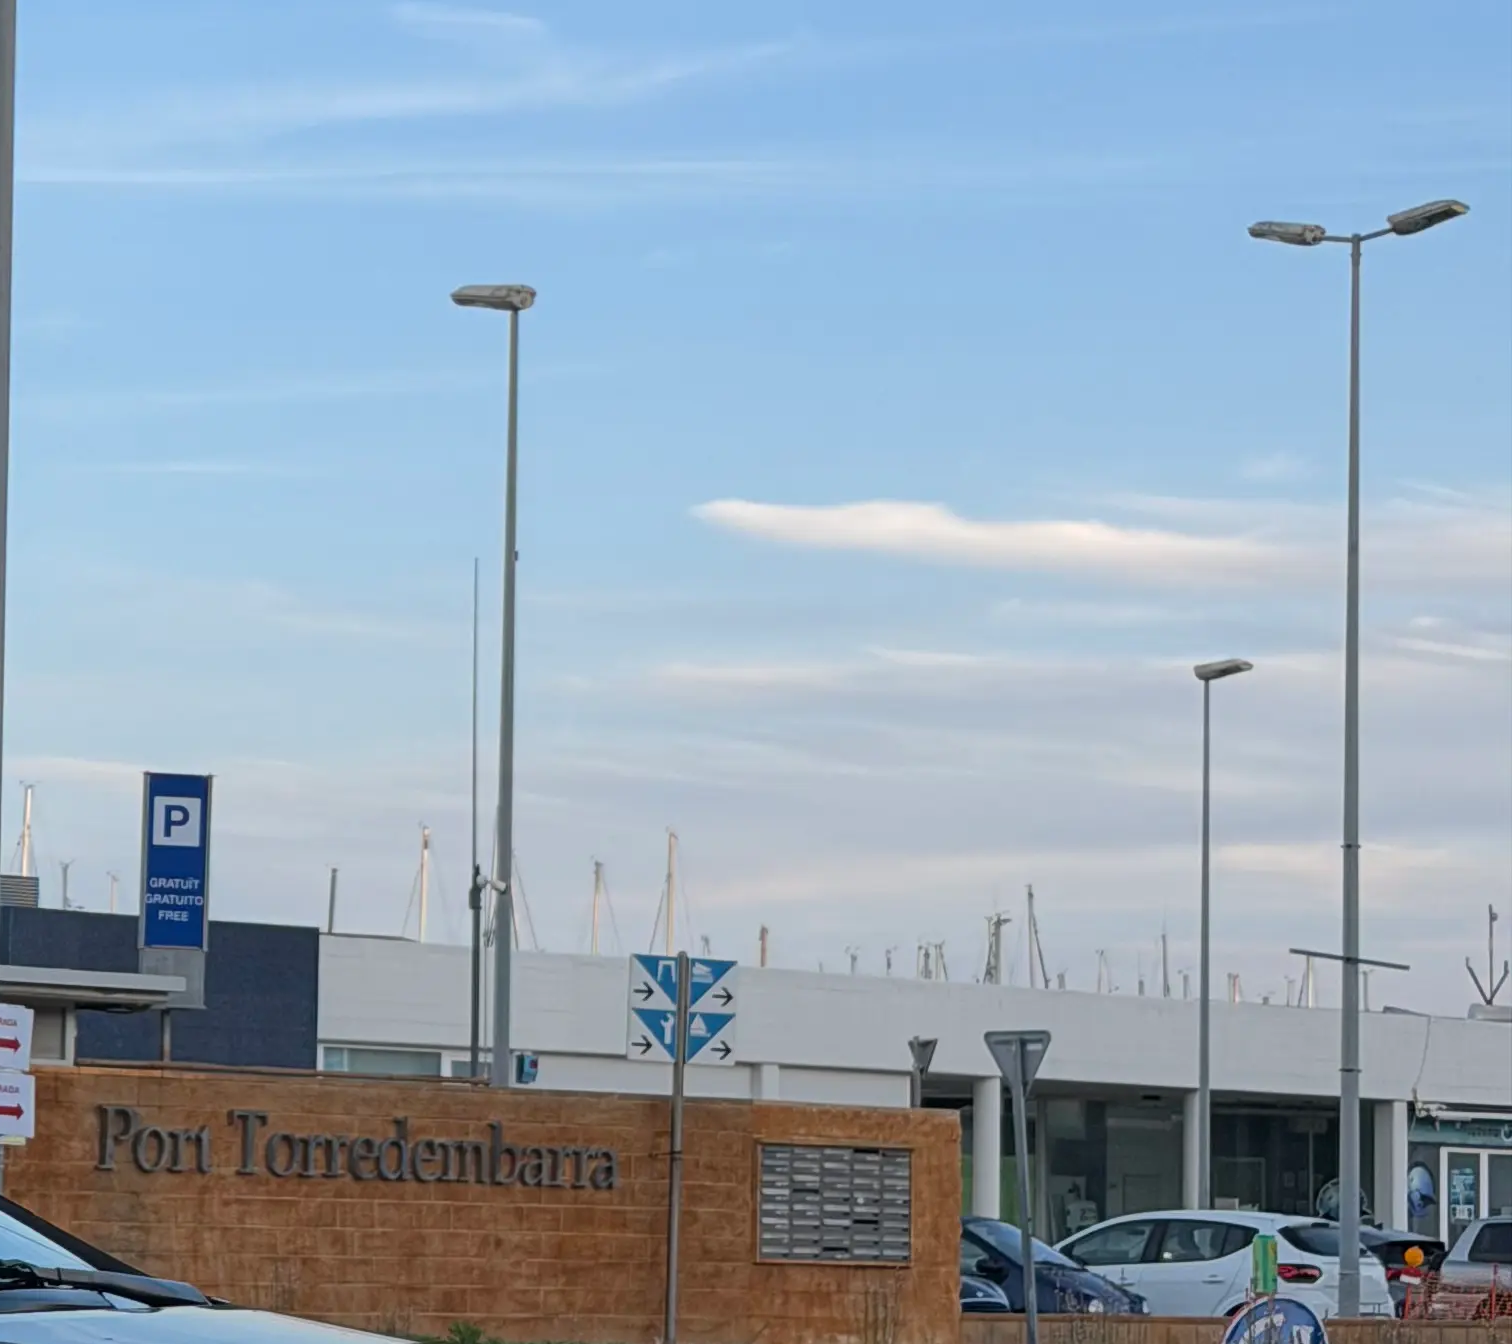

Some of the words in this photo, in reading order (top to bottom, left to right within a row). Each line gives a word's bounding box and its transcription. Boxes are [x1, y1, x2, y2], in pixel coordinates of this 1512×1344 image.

[163, 804, 190, 838] P
[145, 893, 204, 906] GRATUITO
[158, 909, 189, 921] FREE
[95, 1103, 212, 1173] Port
[227, 1109, 620, 1190] Torredembarra
